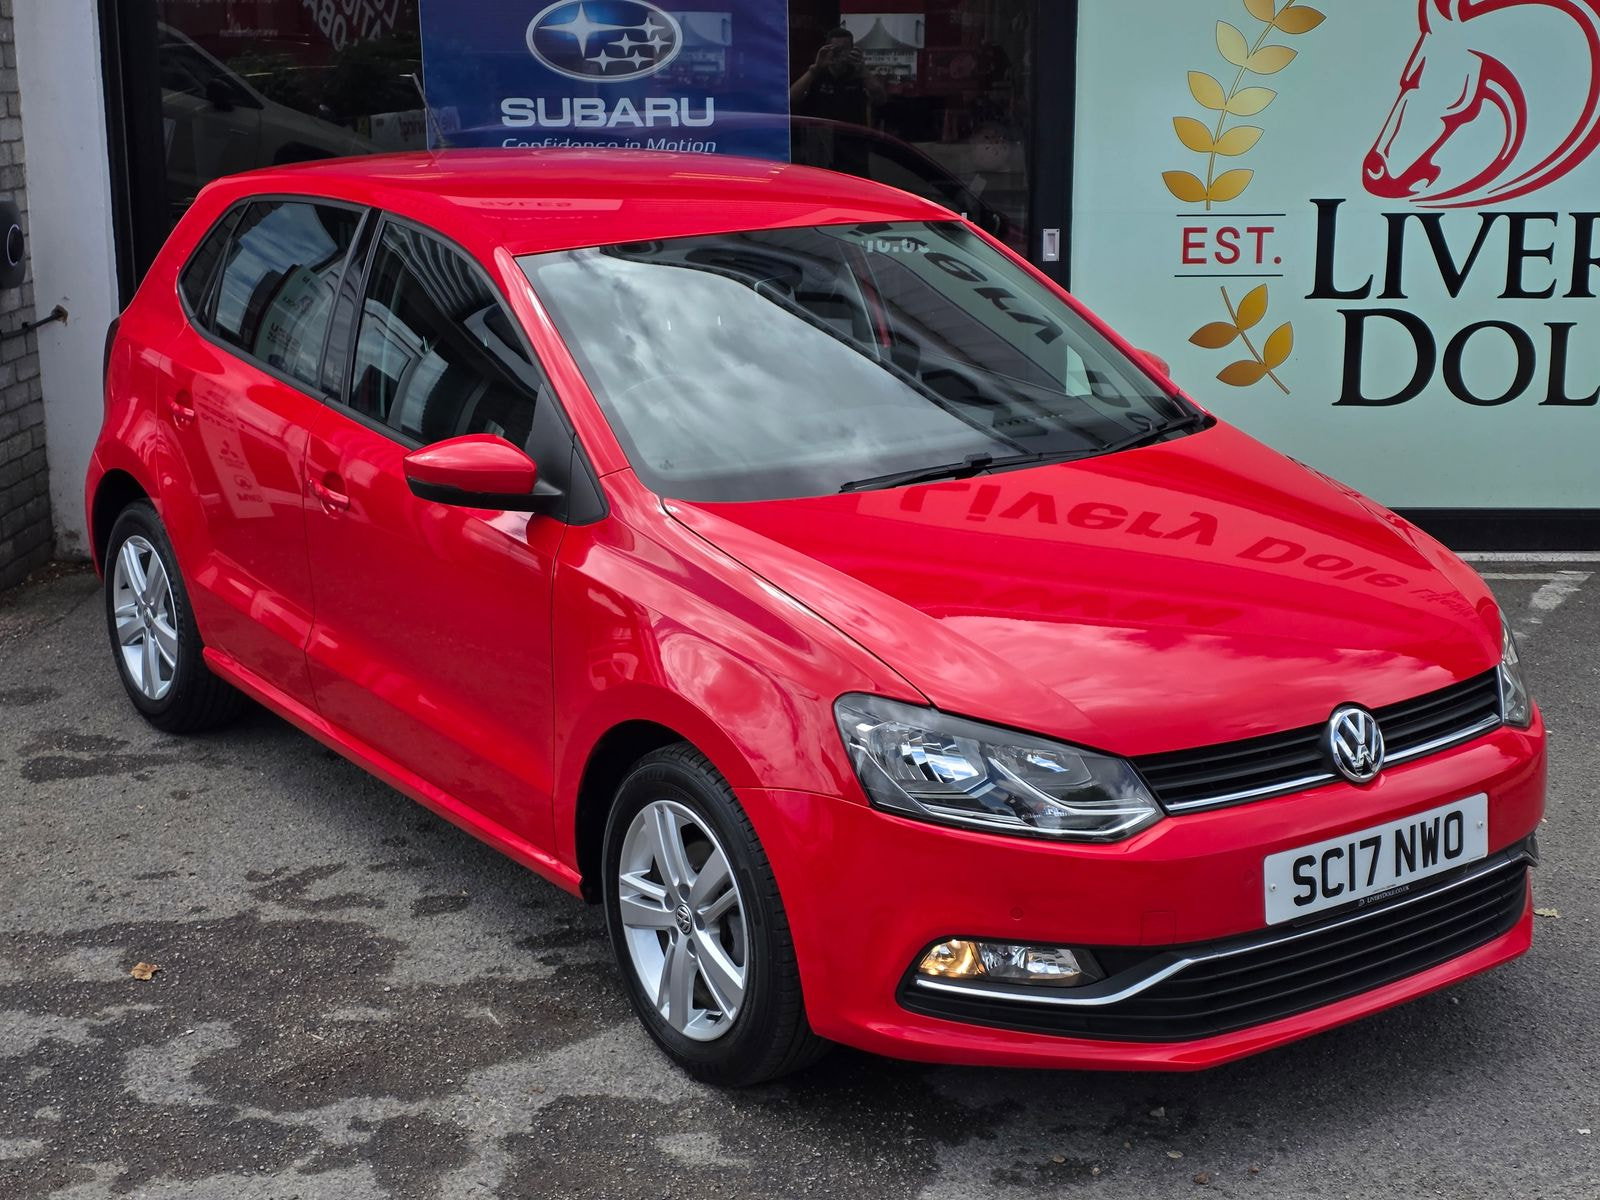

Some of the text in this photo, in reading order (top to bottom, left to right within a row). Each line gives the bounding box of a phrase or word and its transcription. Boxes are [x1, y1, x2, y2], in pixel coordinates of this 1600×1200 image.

[501, 97, 715, 127] SUBARU
[1182, 227, 1282, 264] EST.
[1293, 810, 1463, 907] SC17 NWO
